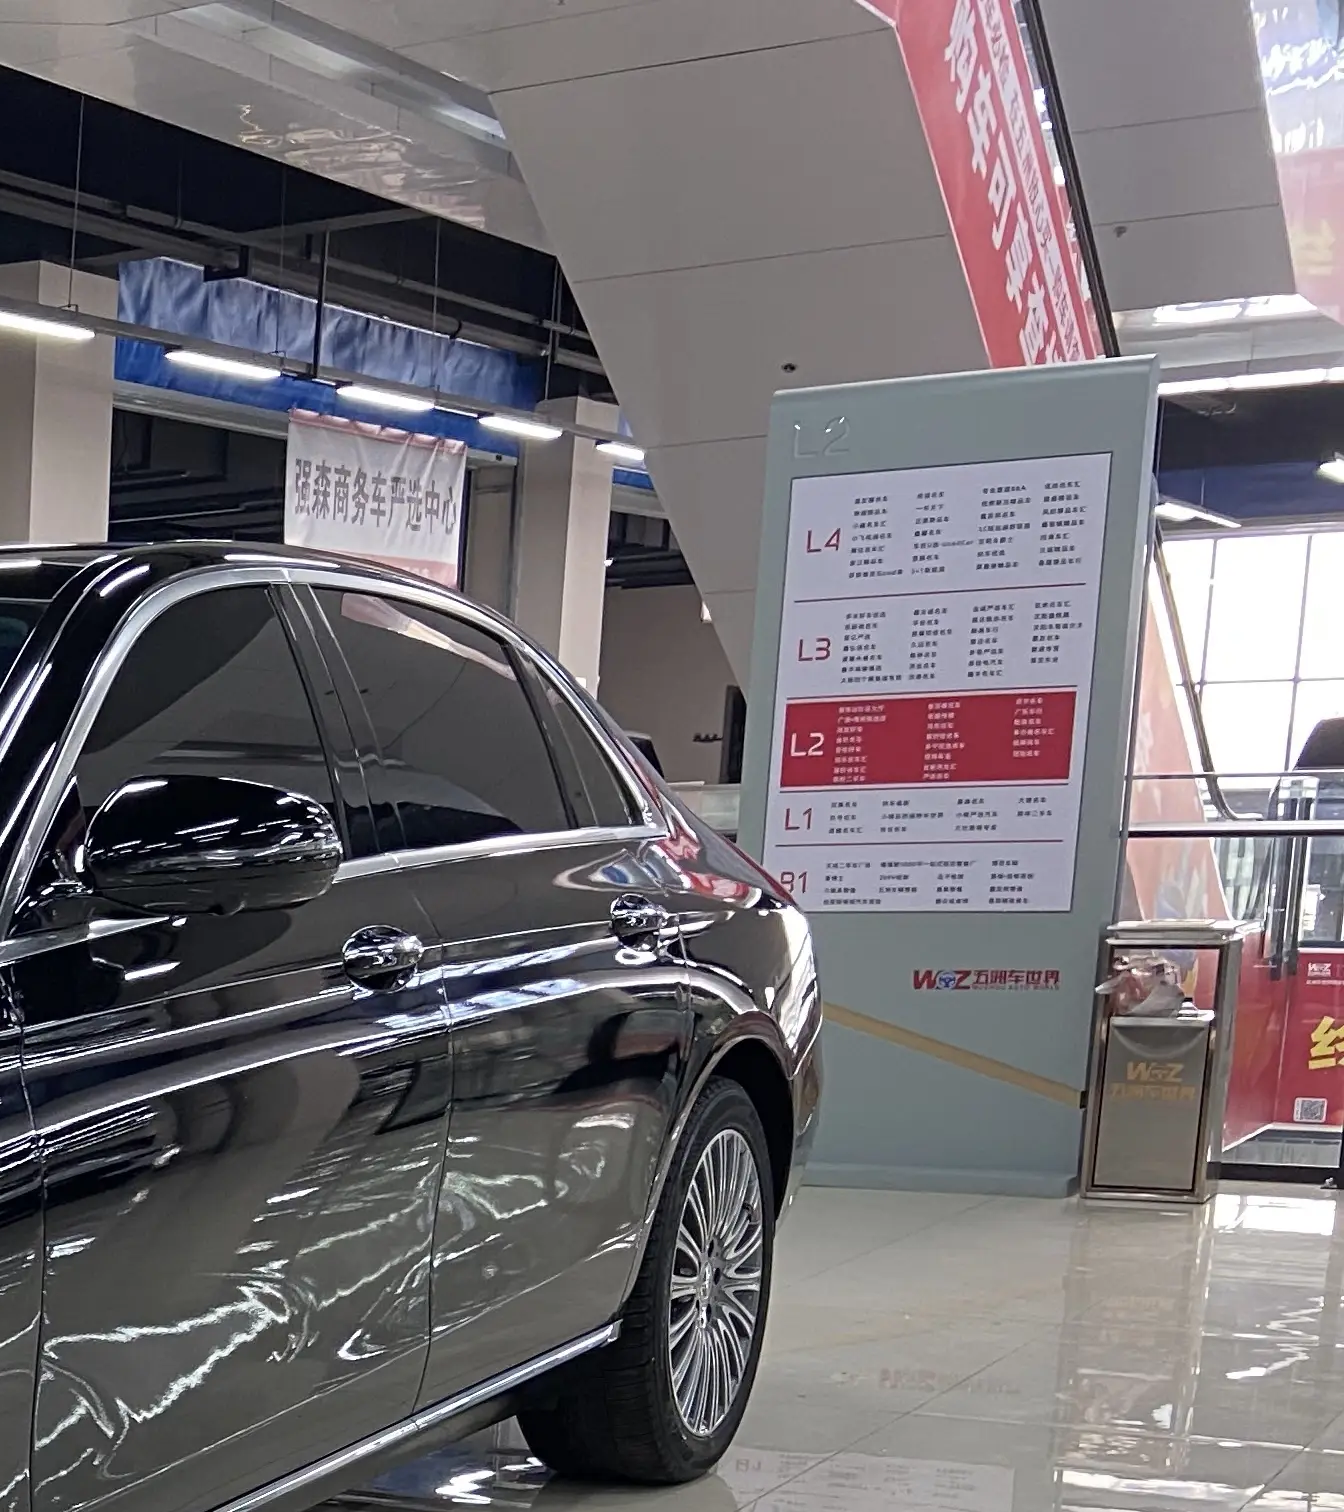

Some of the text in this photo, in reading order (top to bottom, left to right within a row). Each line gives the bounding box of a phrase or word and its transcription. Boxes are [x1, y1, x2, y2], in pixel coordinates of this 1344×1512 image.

[294, 457, 458, 536] 强森商务车严选中心
[806, 527, 842, 553] L4
[797, 637, 832, 662] L3
[790, 732, 825, 758] L2
[784, 807, 813, 831] L1
